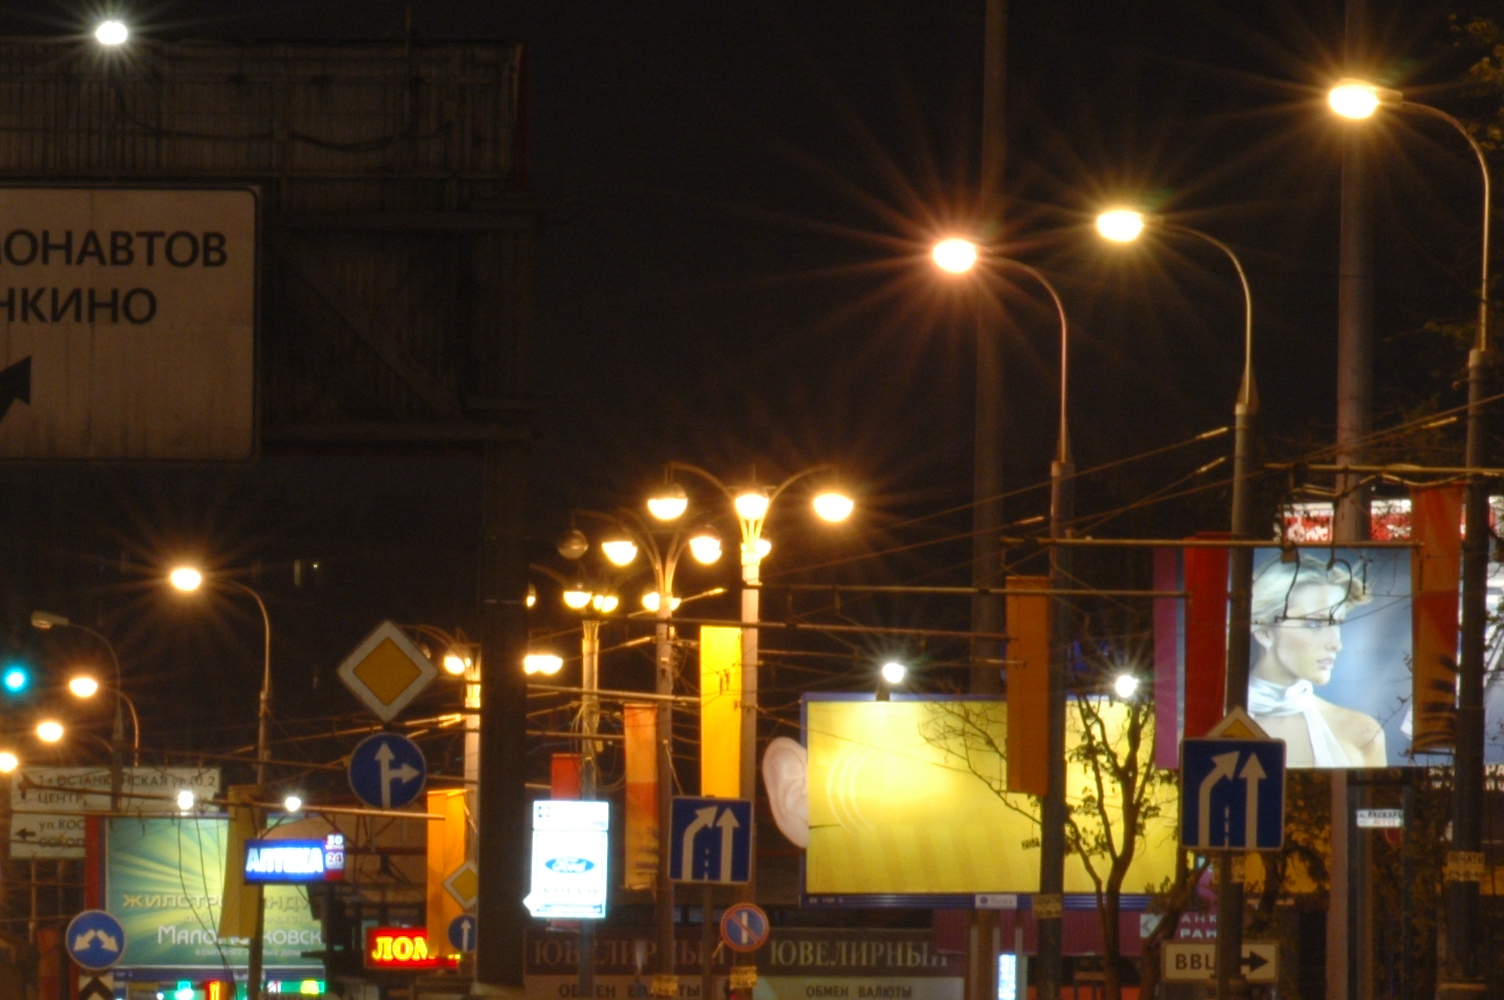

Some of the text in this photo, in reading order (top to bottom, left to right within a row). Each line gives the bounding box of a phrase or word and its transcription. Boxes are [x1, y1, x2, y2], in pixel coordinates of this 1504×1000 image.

[56, 773, 168, 787] ОСТАНКНСКАЯ
[806, 985, 913, 999] ОБМЕН ВАЛЮТЫ
